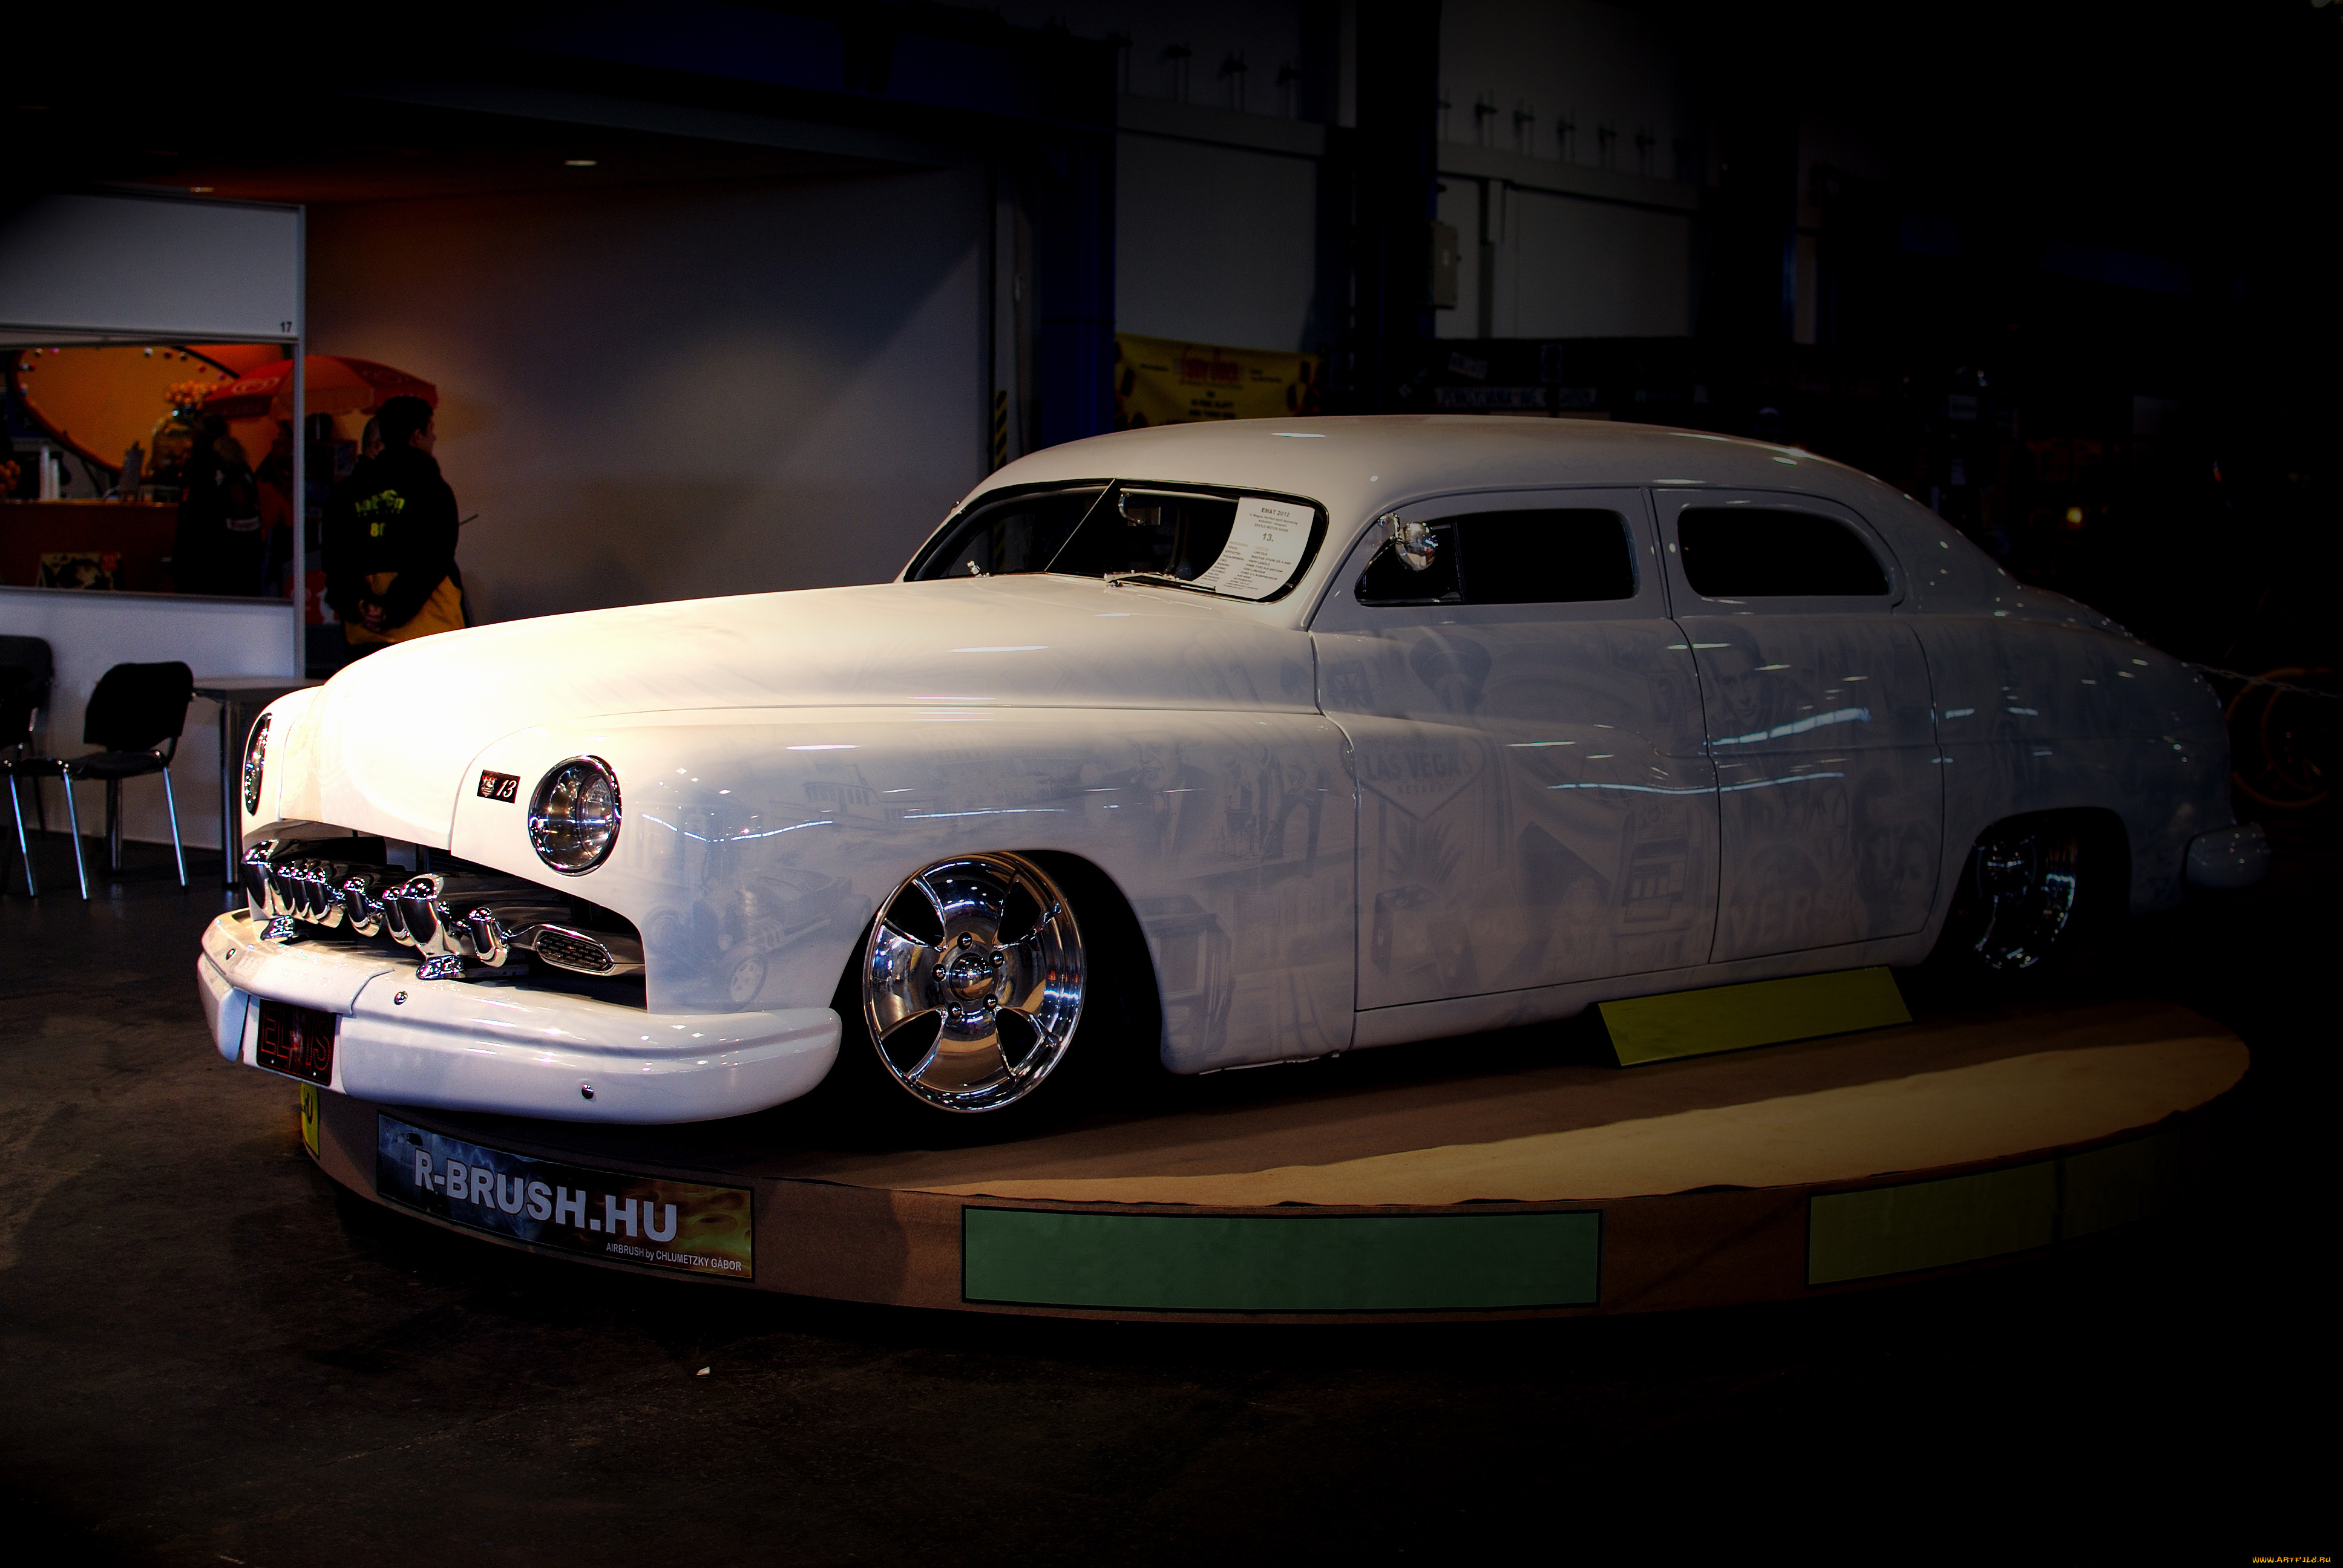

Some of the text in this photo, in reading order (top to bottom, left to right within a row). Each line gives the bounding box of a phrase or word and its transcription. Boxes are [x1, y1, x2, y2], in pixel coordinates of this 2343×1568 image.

[281, 322, 292, 333] 17
[496, 779, 517, 798] 13
[261, 1001, 331, 1071] ELIS
[415, 1148, 678, 1243] R-BRUSH.HU
[606, 1242, 742, 1272] AIRBRUSH by CHLUMETZKY GÁBOR
